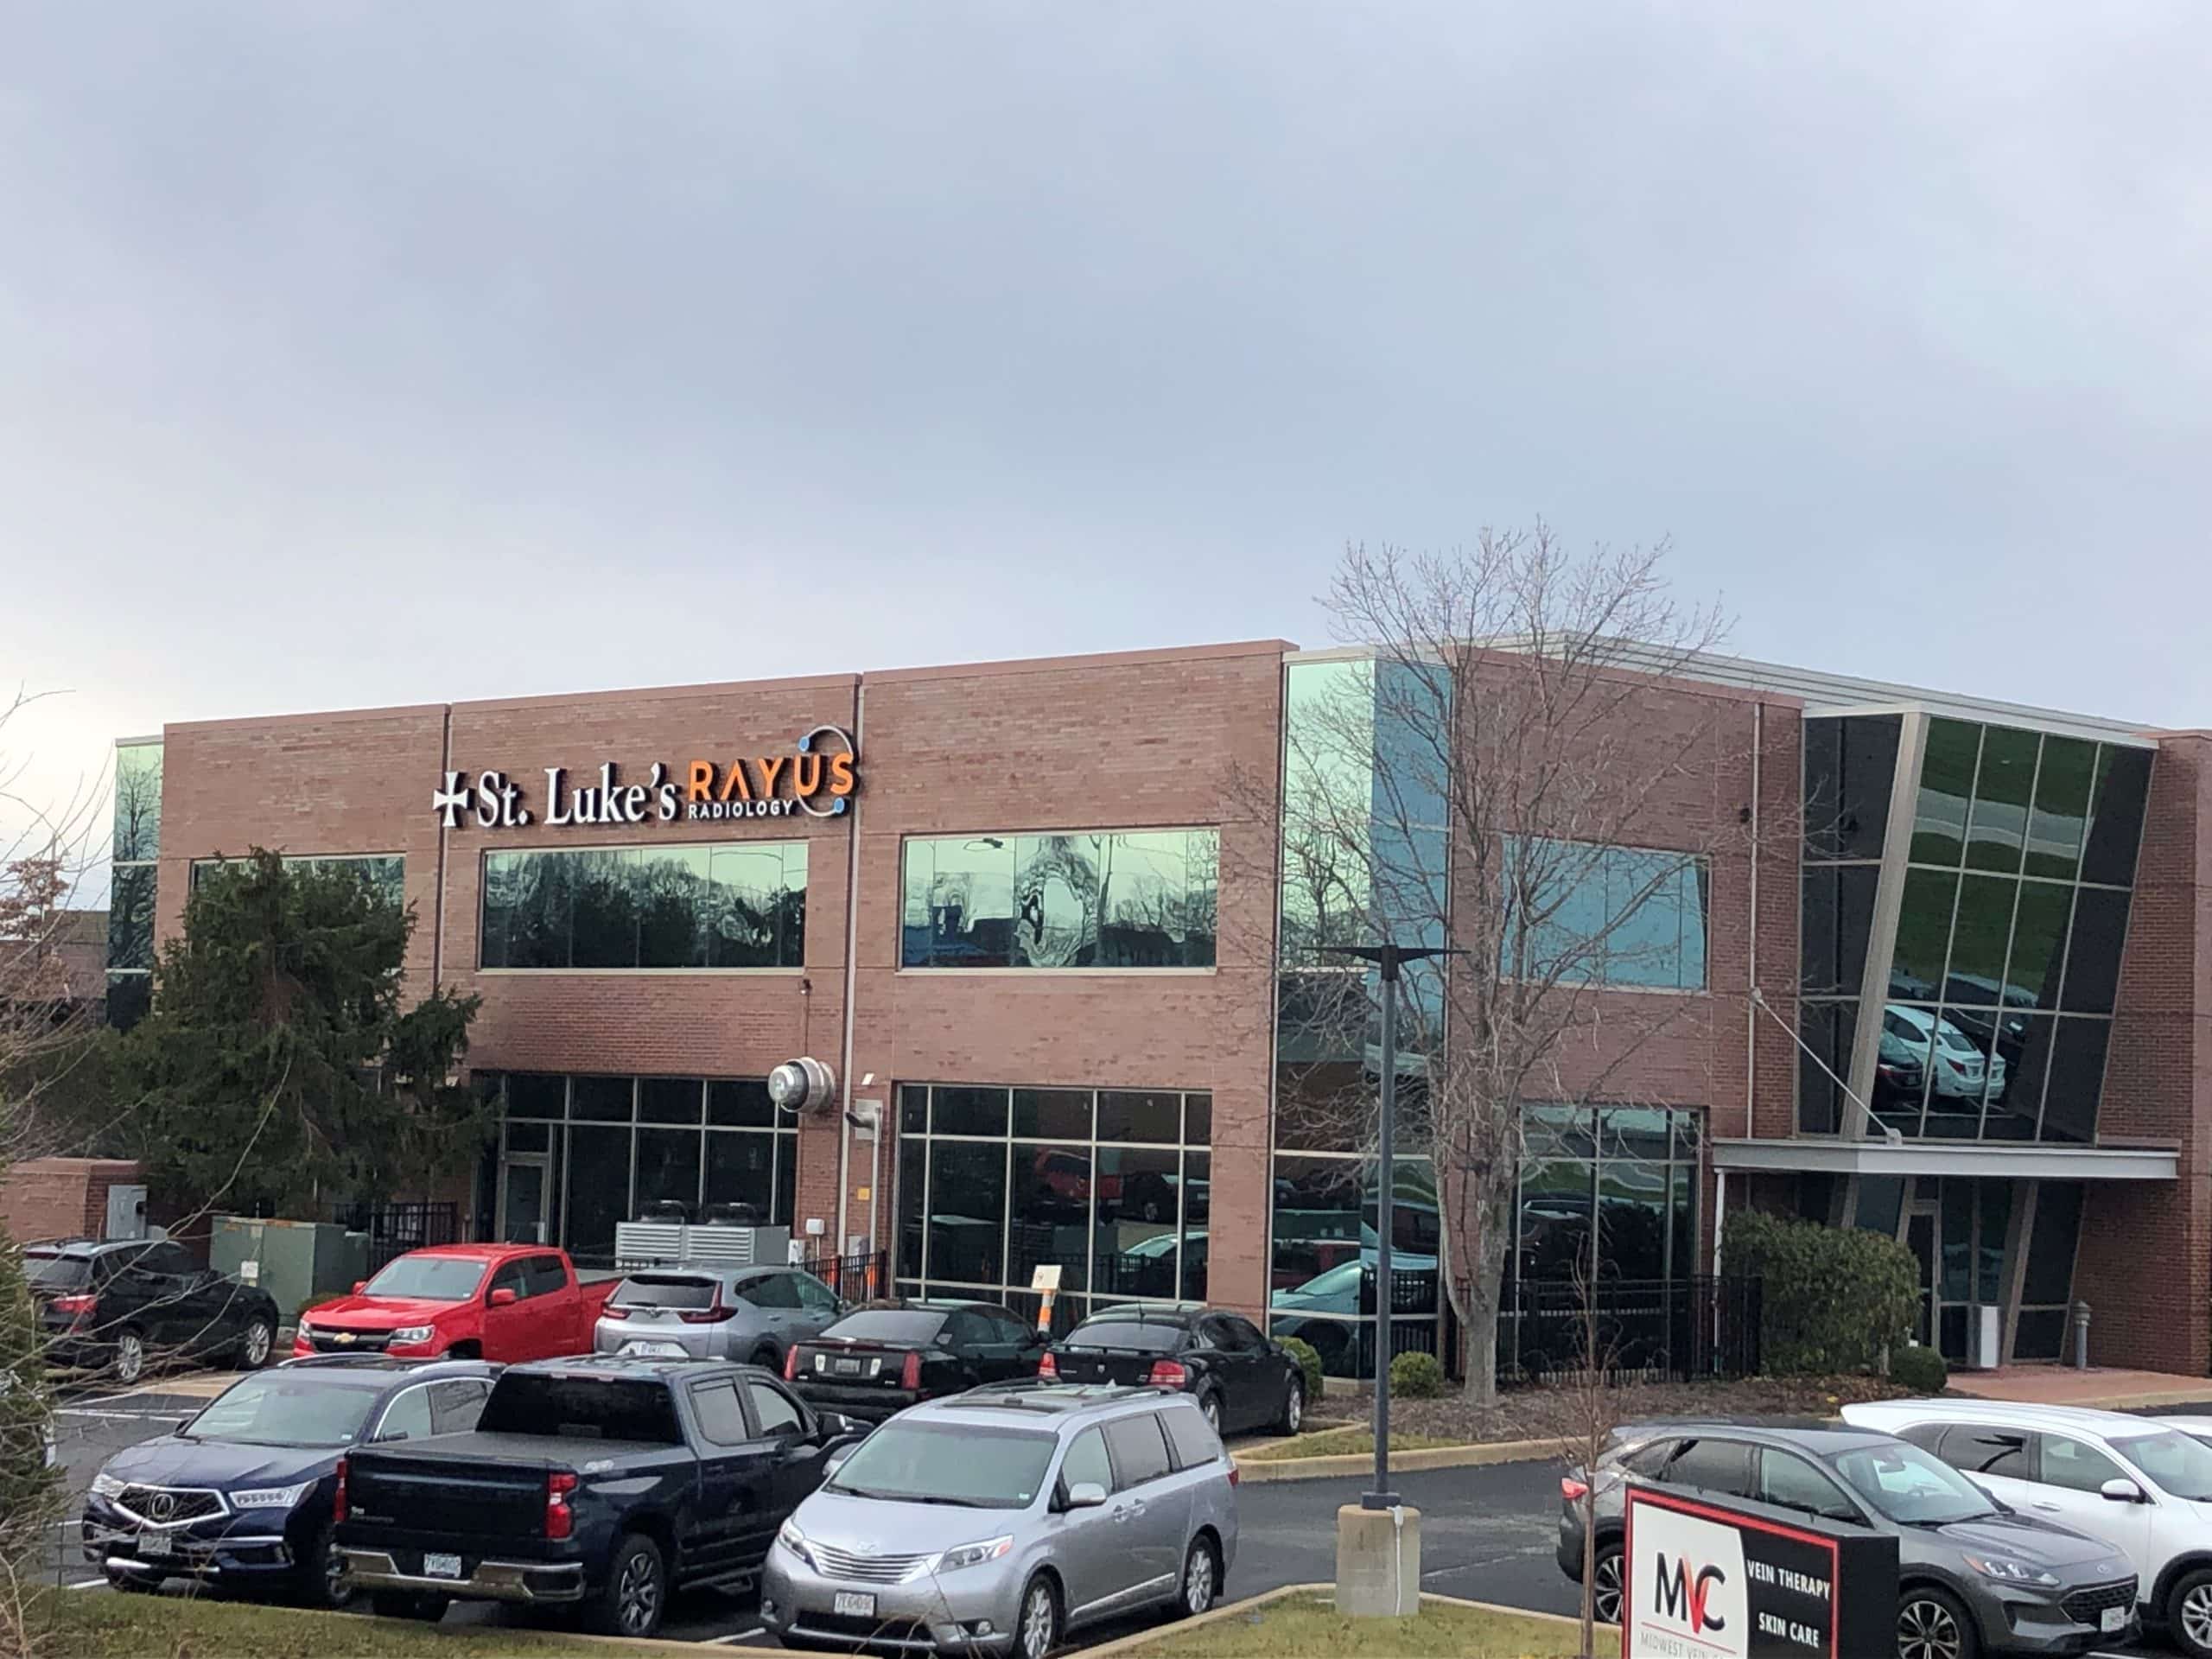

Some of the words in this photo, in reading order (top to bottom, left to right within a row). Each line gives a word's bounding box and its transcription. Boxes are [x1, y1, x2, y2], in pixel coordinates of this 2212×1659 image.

[476, 770, 529, 827] St.
[543, 761, 677, 824] Luke's
[689, 753, 855, 802] RAYUS
[688, 799, 793, 819] RADIOLOGY
[1655, 1552, 1726, 1634] MVC
[1746, 1559, 1775, 1584] VEIN
[1777, 1567, 1831, 1600] THERAPY
[1640, 1631, 1683, 1657] MIDWEST
[1758, 1611, 1786, 1637] SKIN
[1789, 1622, 1820, 1649] CARE
